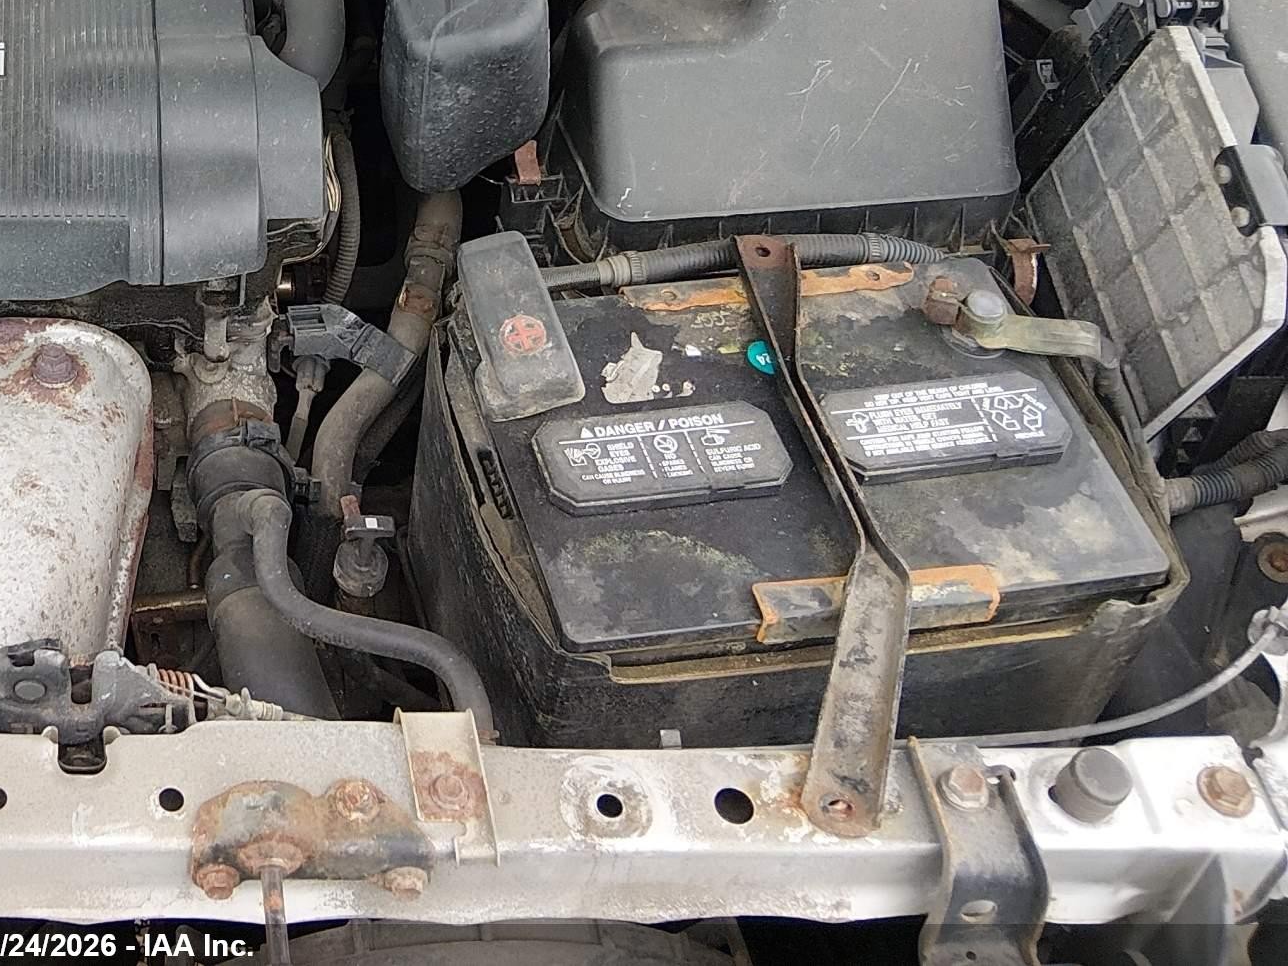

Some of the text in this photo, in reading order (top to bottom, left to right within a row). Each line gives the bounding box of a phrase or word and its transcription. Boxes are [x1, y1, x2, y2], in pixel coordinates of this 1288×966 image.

[594, 414, 724, 436] DANGER / POISON
[743, 443, 761, 451] ACID
